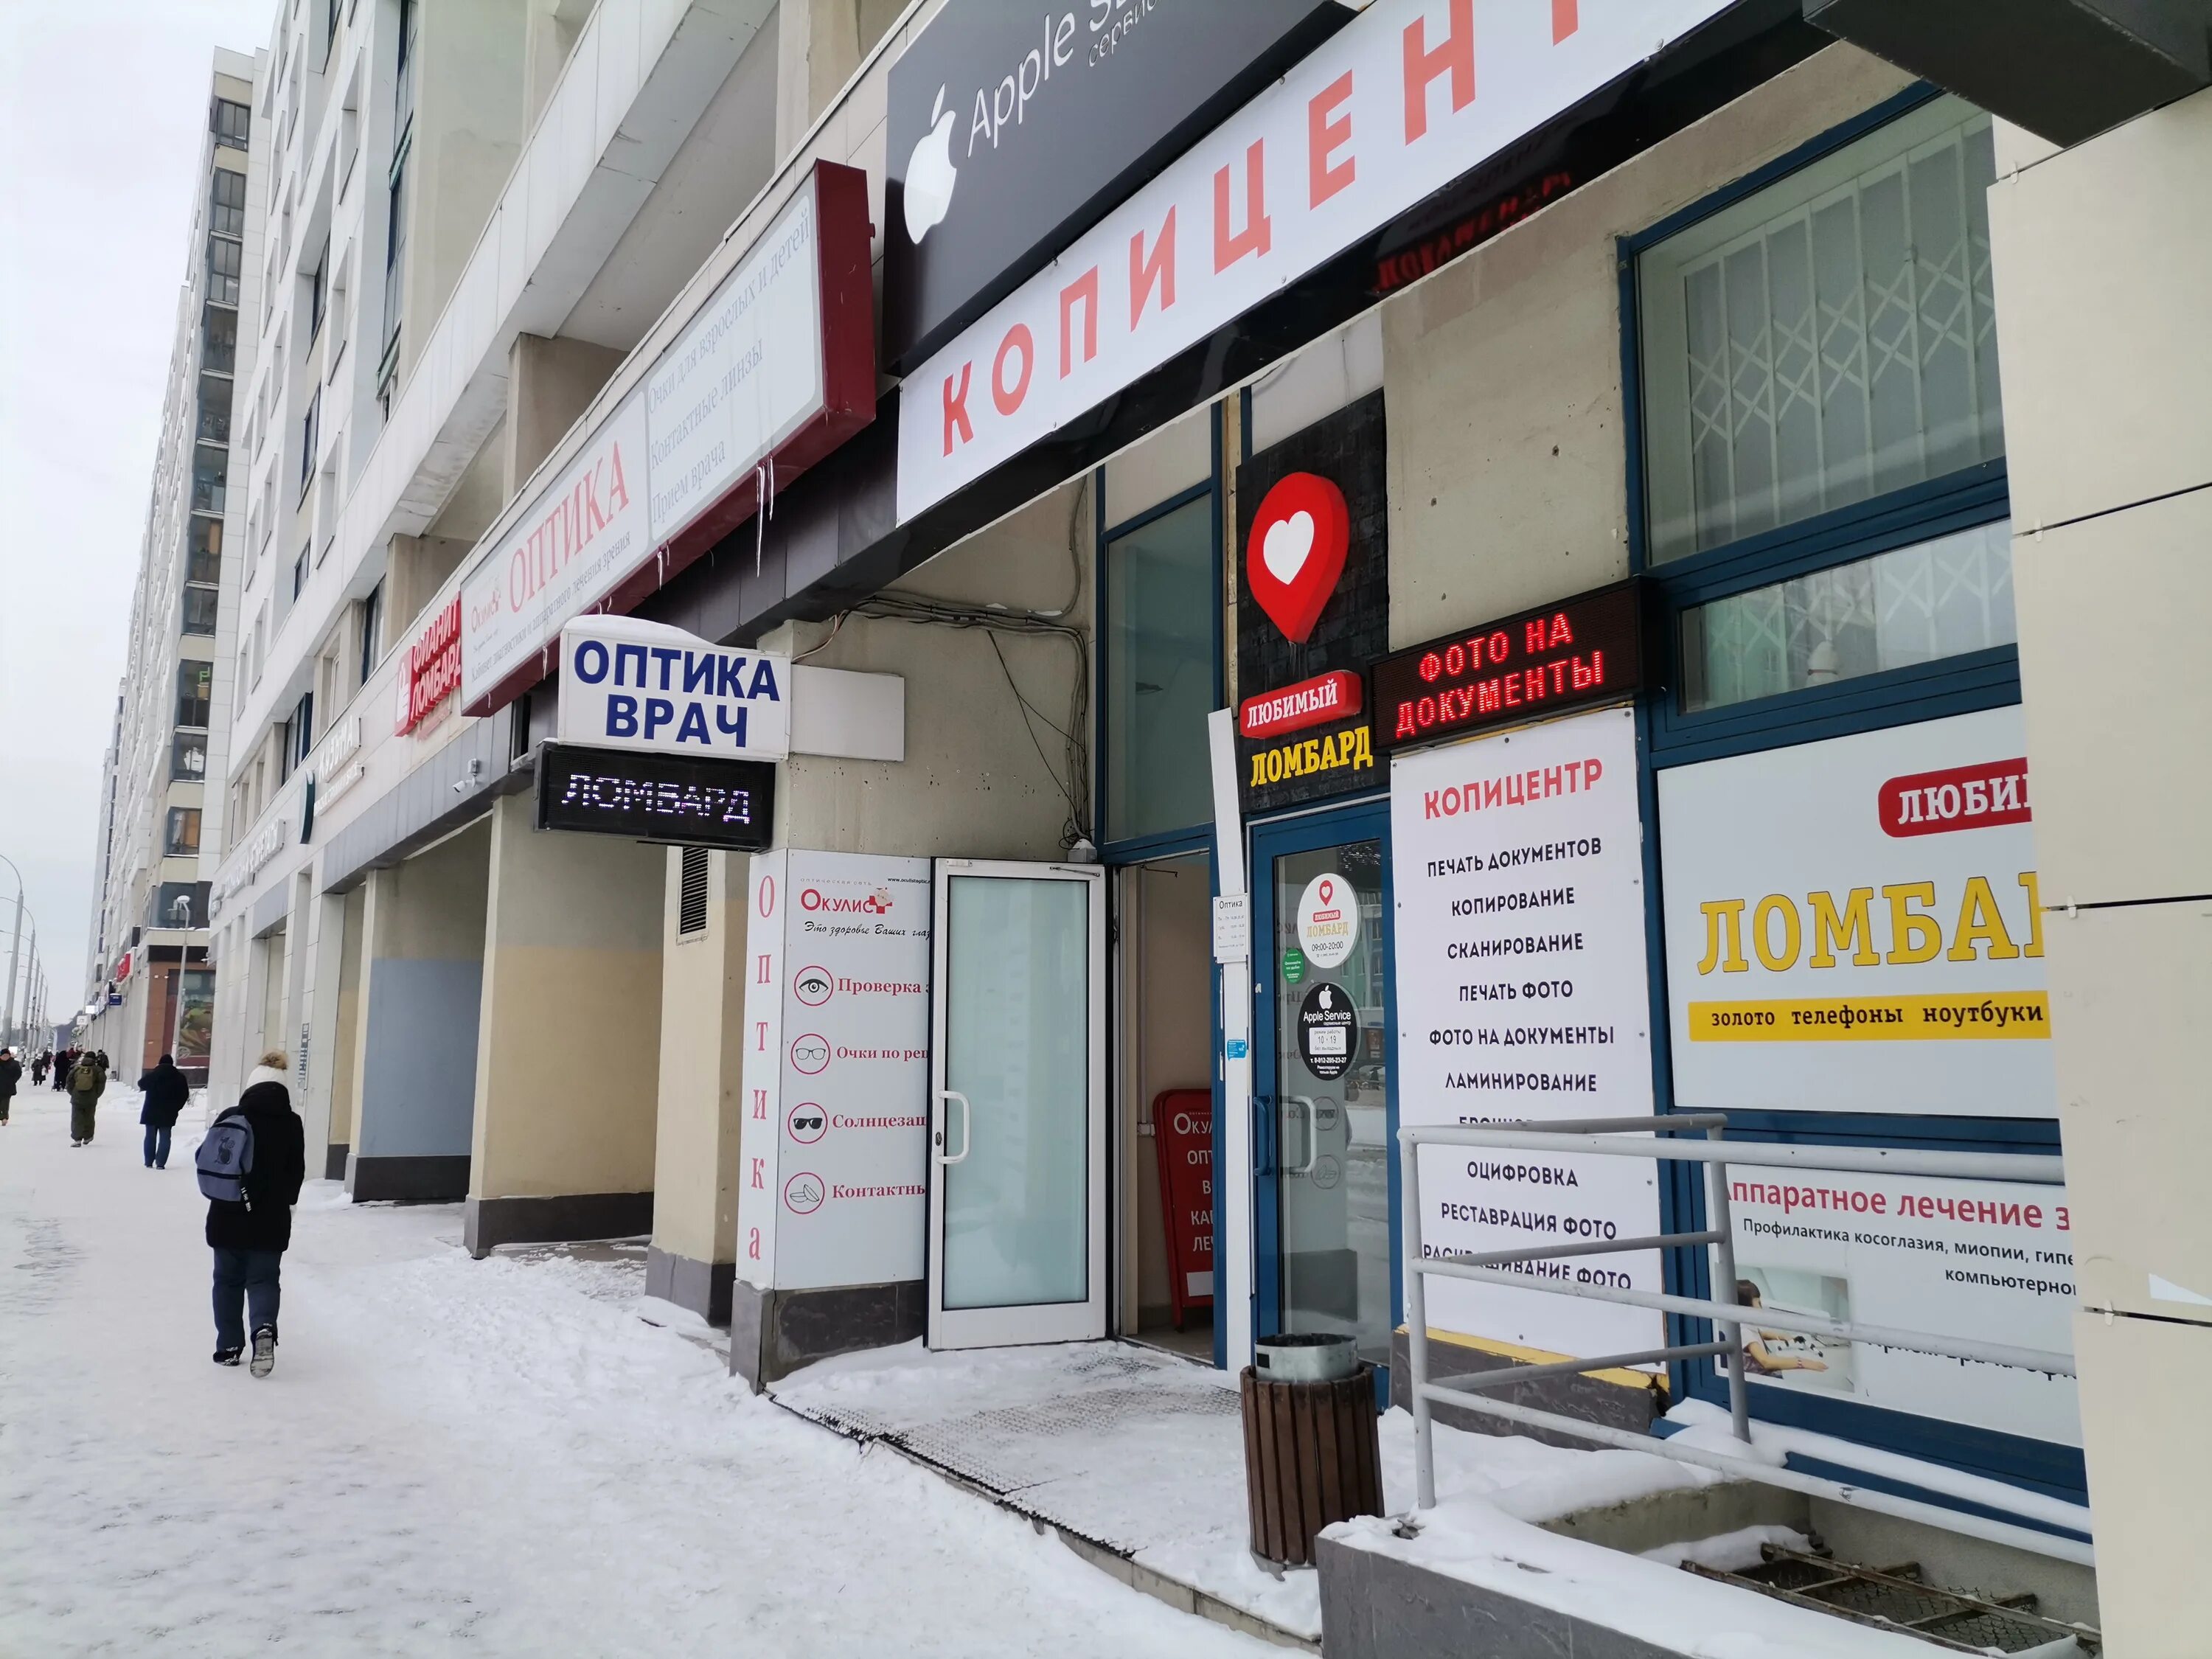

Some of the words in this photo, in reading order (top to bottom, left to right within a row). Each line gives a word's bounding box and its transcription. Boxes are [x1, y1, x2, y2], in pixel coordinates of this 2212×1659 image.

[967, 12, 1076, 158] Apple
[649, 373, 675, 414] Очки
[677, 352, 697, 384] для
[700, 278, 756, 360] взрослых
[758, 268, 768, 293] и
[771, 209, 810, 285] детей
[651, 387, 718, 471] Контактные
[720, 339, 763, 400] линзы
[652, 474, 688, 524] Прием
[692, 441, 726, 490] врача
[509, 440, 630, 613] ОПТИКА
[572, 560, 602, 598] лечения
[602, 531, 631, 571] зрения
[1419, 630, 1509, 683] ФОТО
[1526, 612, 1574, 654] НА
[574, 639, 780, 702] ОПТИКА
[1247, 678, 1338, 729] ЛЮБИМЫЙ
[1395, 650, 1605, 739] ДОКУМЕНТЫ
[605, 693, 748, 748] ВРАЧ
[1251, 725, 1374, 787] ЛОМБАРД
[561, 774, 751, 824] ЛОМБАРД
[1424, 758, 1603, 820] КОПИЦЕНТР
[1427, 855, 1484, 877] ПЕЧАТЬ
[1488, 838, 1602, 872] ДОКУМЕНТОВ
[1219, 900, 1243, 910] Оптика
[1452, 887, 1576, 917] КОПИРОВАНИЕ
[804, 921, 827, 933] Это
[829, 925, 870, 937] здоровье
[874, 924, 906, 936] Ваших
[1307, 922, 1349, 938] ЛОМБАРД
[1311, 940, 1344, 952] 09:00-20:00
[1447, 933, 1584, 959] СКАНИРОВАНИЕ
[838, 978, 922, 995] Проверка
[1460, 983, 1517, 1001] ПЕЧАТЬ
[1522, 980, 1573, 999] ФОТО
[1303, 1010, 1324, 1025] Apple
[1324, 1010, 1352, 1021] Service
[1711, 1009, 1775, 1026] золото
[1791, 1004, 1904, 1029] телефоны
[1923, 999, 2044, 1027] ноутбуки
[836, 1046, 878, 1060] Очки
[881, 1048, 900, 1059] по
[1318, 1035, 1325, 1044] 10
[1329, 1034, 1337, 1044] 19
[1429, 1029, 1473, 1046] ФОТО
[1478, 1029, 1500, 1046] НА
[1503, 1026, 1615, 1046] ДОКУМЕНТЫ
[1445, 1072, 1597, 1092] ЛАМИНИРОВАНИЕ
[1467, 1161, 1579, 1187] ОЦИФРОВКА
[1441, 1202, 1557, 1233] РЕСТАВРАЦИЯ
[1563, 1217, 1617, 1240] ФОТО
[1726, 1181, 1887, 1215] ппаратное
[1897, 1193, 2043, 1229] лечение
[1743, 1217, 1849, 1242] Профилактика
[1854, 1234, 1949, 1255] косоглазия,
[1954, 1242, 2029, 1264] миопии,
[1576, 1267, 1632, 1290] ФОТО
